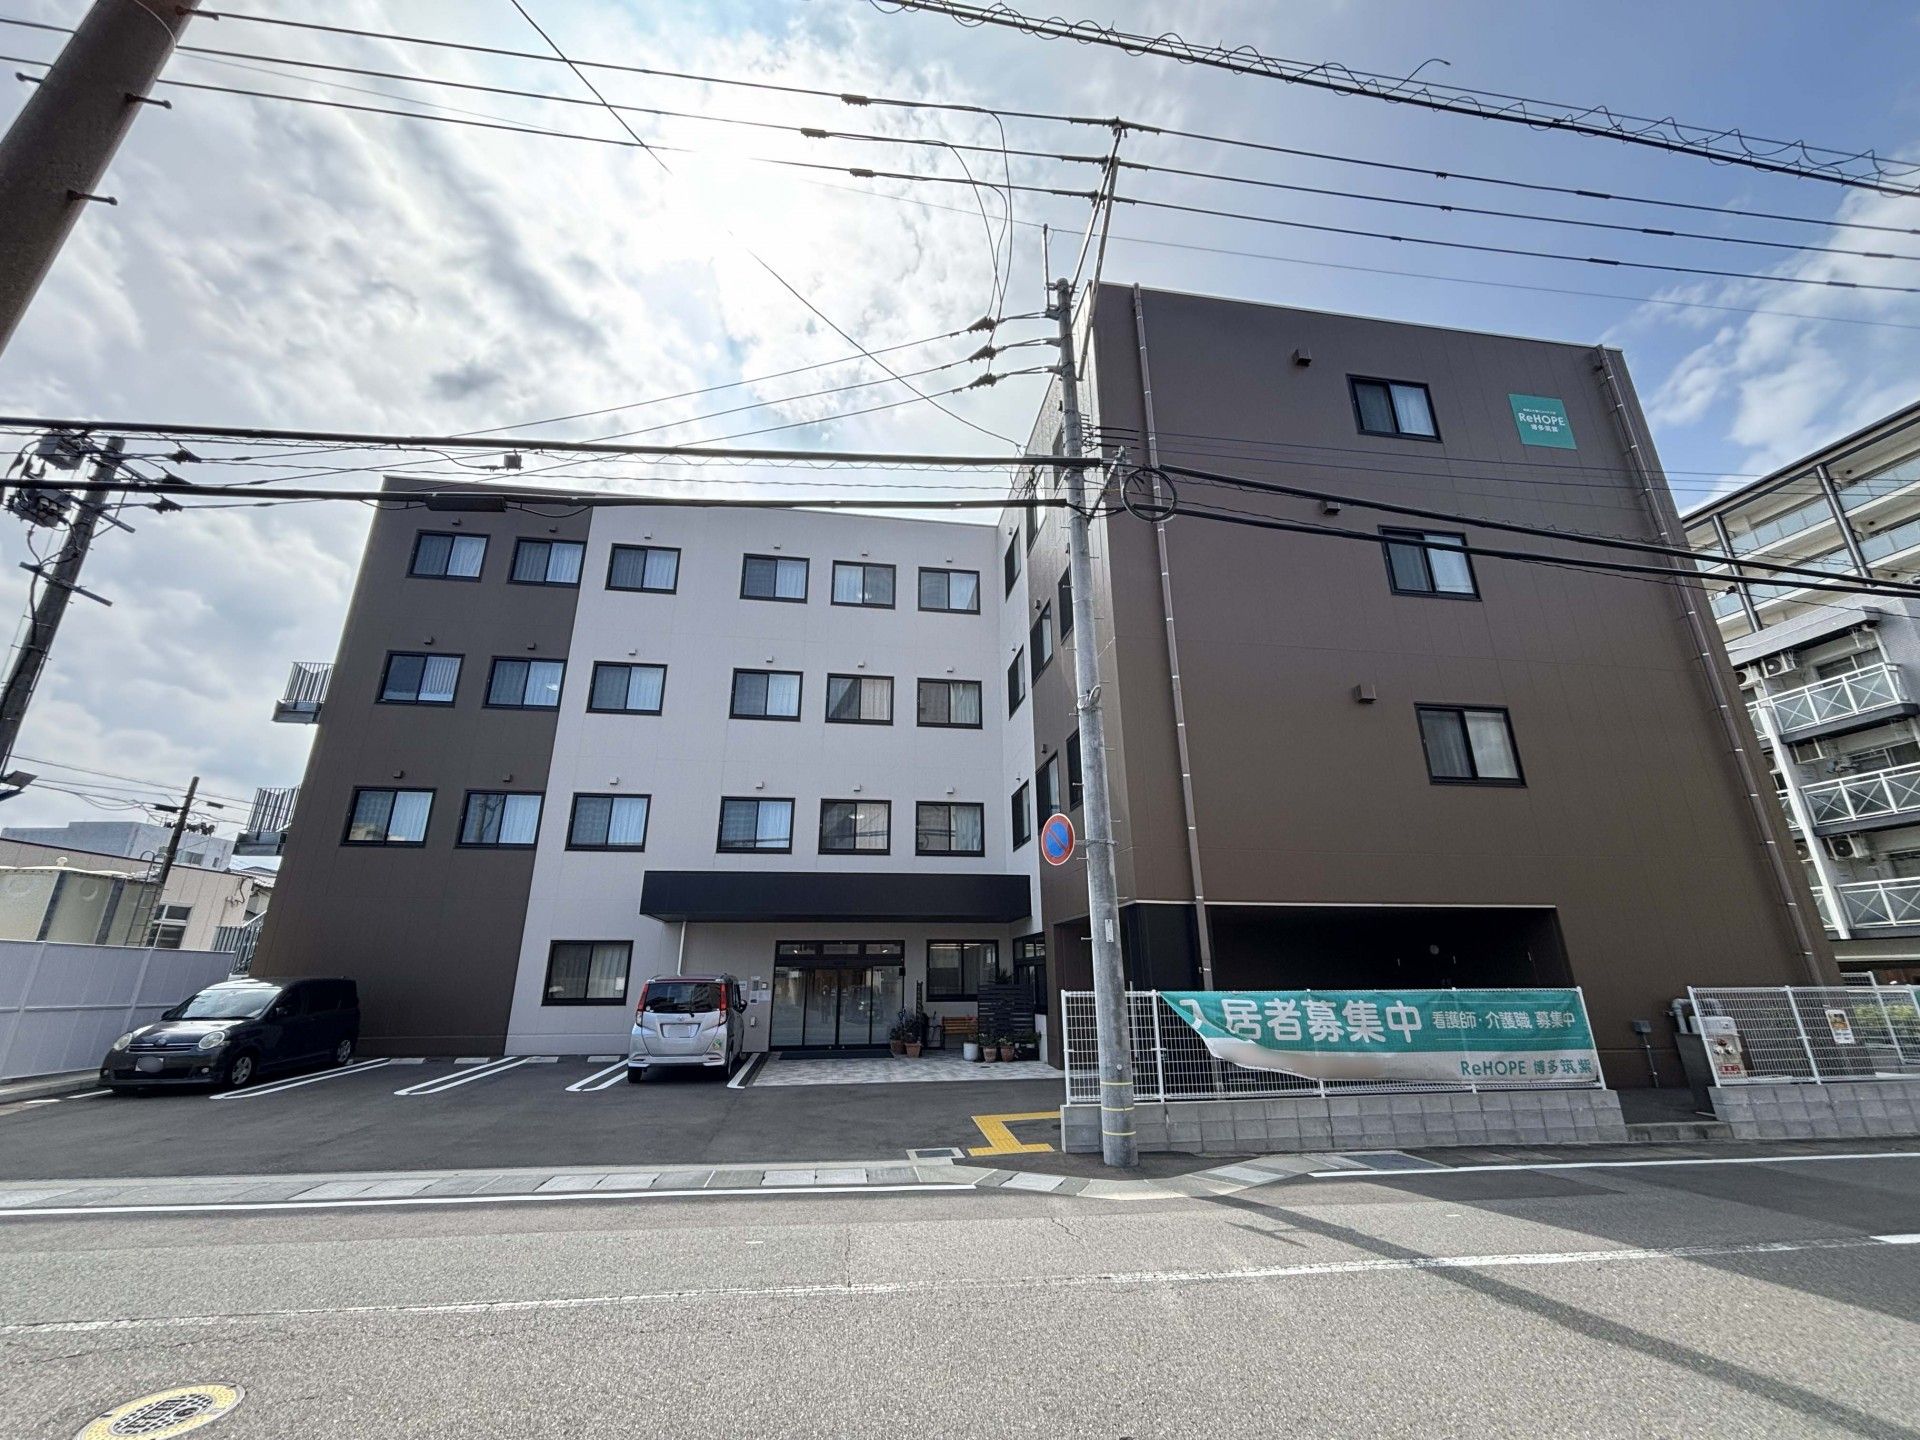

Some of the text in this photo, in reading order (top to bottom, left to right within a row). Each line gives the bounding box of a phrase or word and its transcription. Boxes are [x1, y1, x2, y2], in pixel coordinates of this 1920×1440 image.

[1518, 412, 1565, 426] ReHOPE
[1534, 1010, 1576, 1028] 募集中
[1460, 1058, 1592, 1076] ReHOPE 博多筑紫
